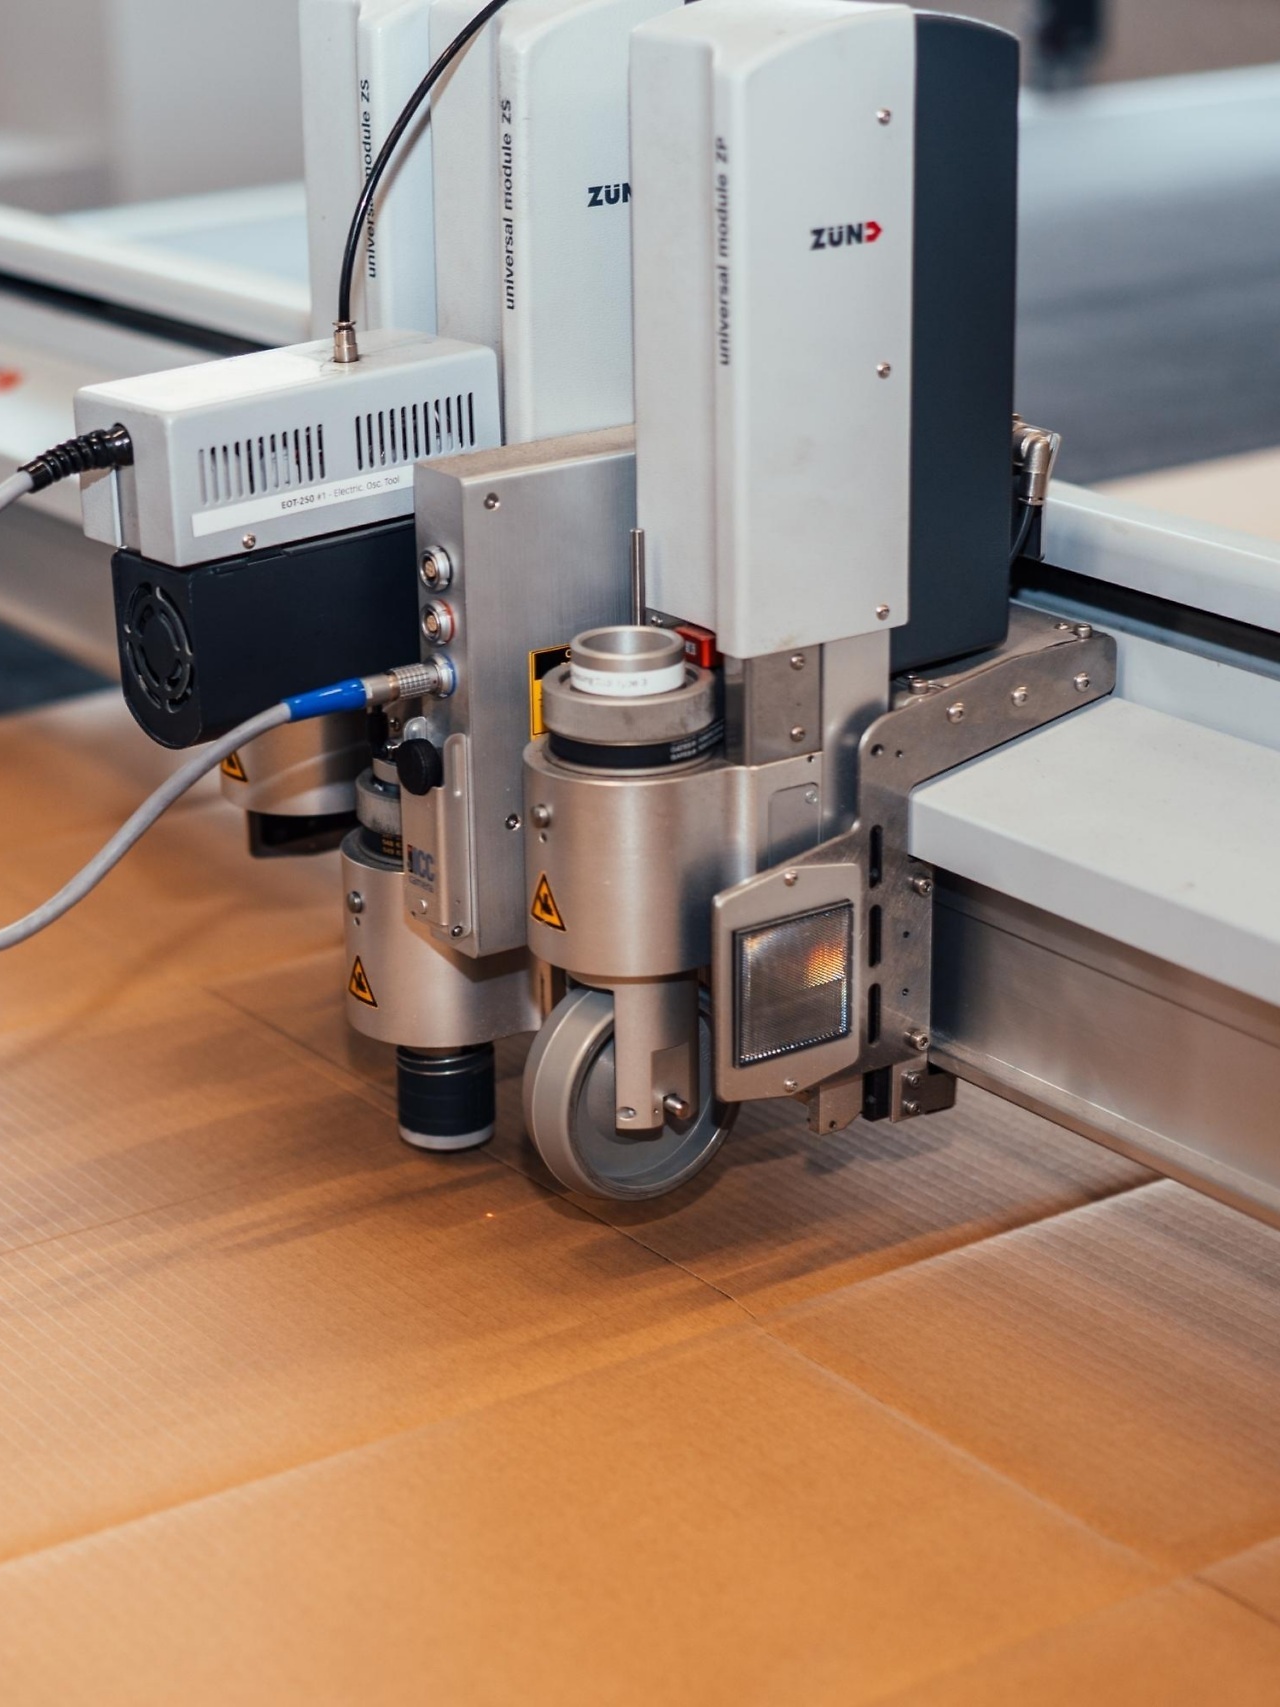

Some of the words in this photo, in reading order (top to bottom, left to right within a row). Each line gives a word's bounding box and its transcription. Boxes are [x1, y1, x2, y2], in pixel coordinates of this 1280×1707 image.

[360, 79, 369, 102] ZS
[501, 99, 512, 125] ZS
[715, 136, 728, 164] ZP
[501, 133, 513, 211] module
[587, 182, 632, 207] ZÜN
[715, 173, 729, 258] module
[810, 221, 883, 251] ZÜND
[502, 217, 515, 310] universal
[716, 264, 730, 366] universal
[281, 494, 315, 509] EOT-250
[384, 475, 400, 487] Tool
